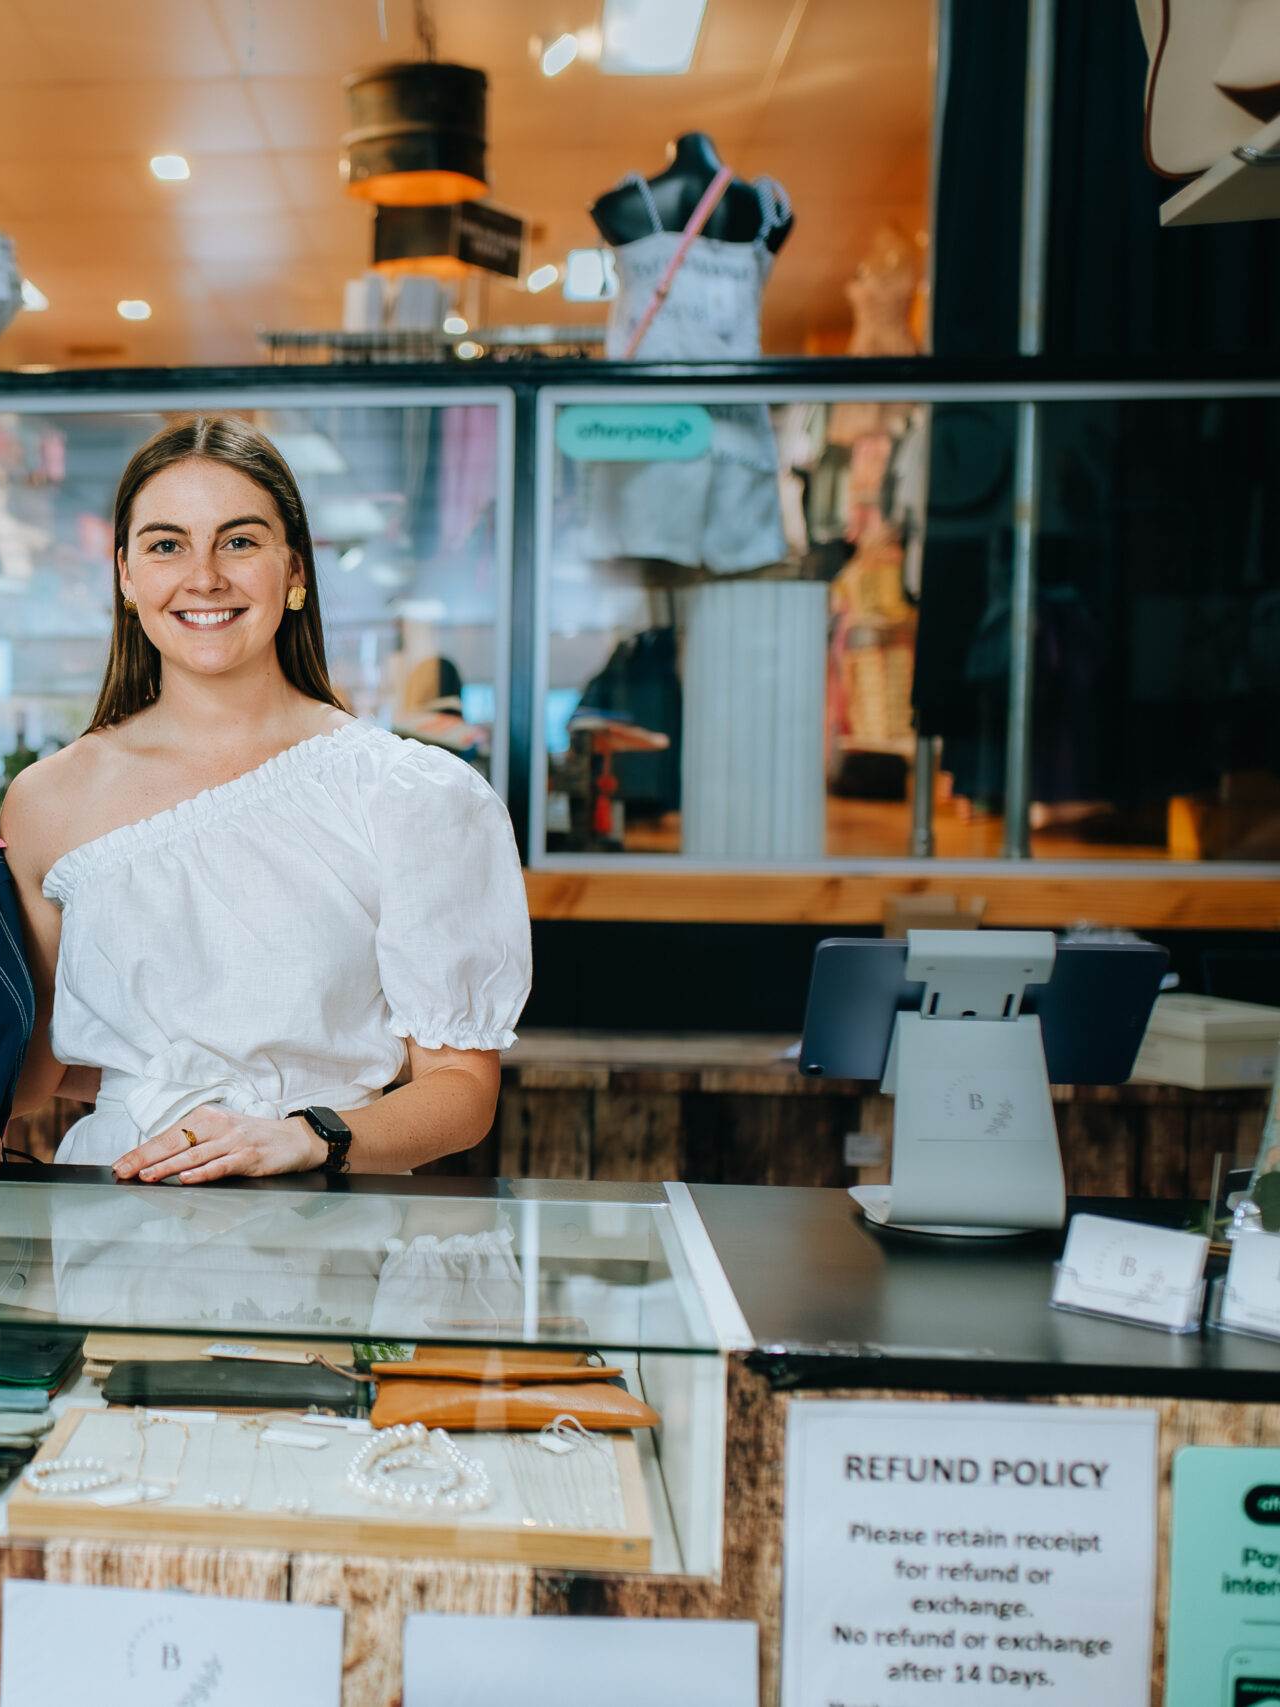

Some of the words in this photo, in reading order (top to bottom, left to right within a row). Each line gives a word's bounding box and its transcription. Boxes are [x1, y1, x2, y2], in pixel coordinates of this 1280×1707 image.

[968, 1092, 985, 1110] B
[1120, 1255, 1137, 1278] B
[843, 1454, 980, 1484] REFUND
[992, 1459, 1110, 1489] POLICY
[849, 1523, 927, 1546] Please
[935, 1527, 1007, 1548] retain
[1015, 1531, 1102, 1556] receipt
[895, 1559, 930, 1580] for
[937, 1561, 1020, 1583] refund
[1026, 1568, 1053, 1585] or
[911, 1595, 1035, 1621] exchange.
[161, 1641, 181, 1671] B
[832, 1625, 867, 1646] No
[874, 1627, 956, 1649] refund
[963, 1633, 989, 1650] or
[995, 1632, 1113, 1659] exchange
[887, 1661, 946, 1683] after
[954, 1664, 983, 1684] 14
[989, 1665, 1056, 1690] Days.
